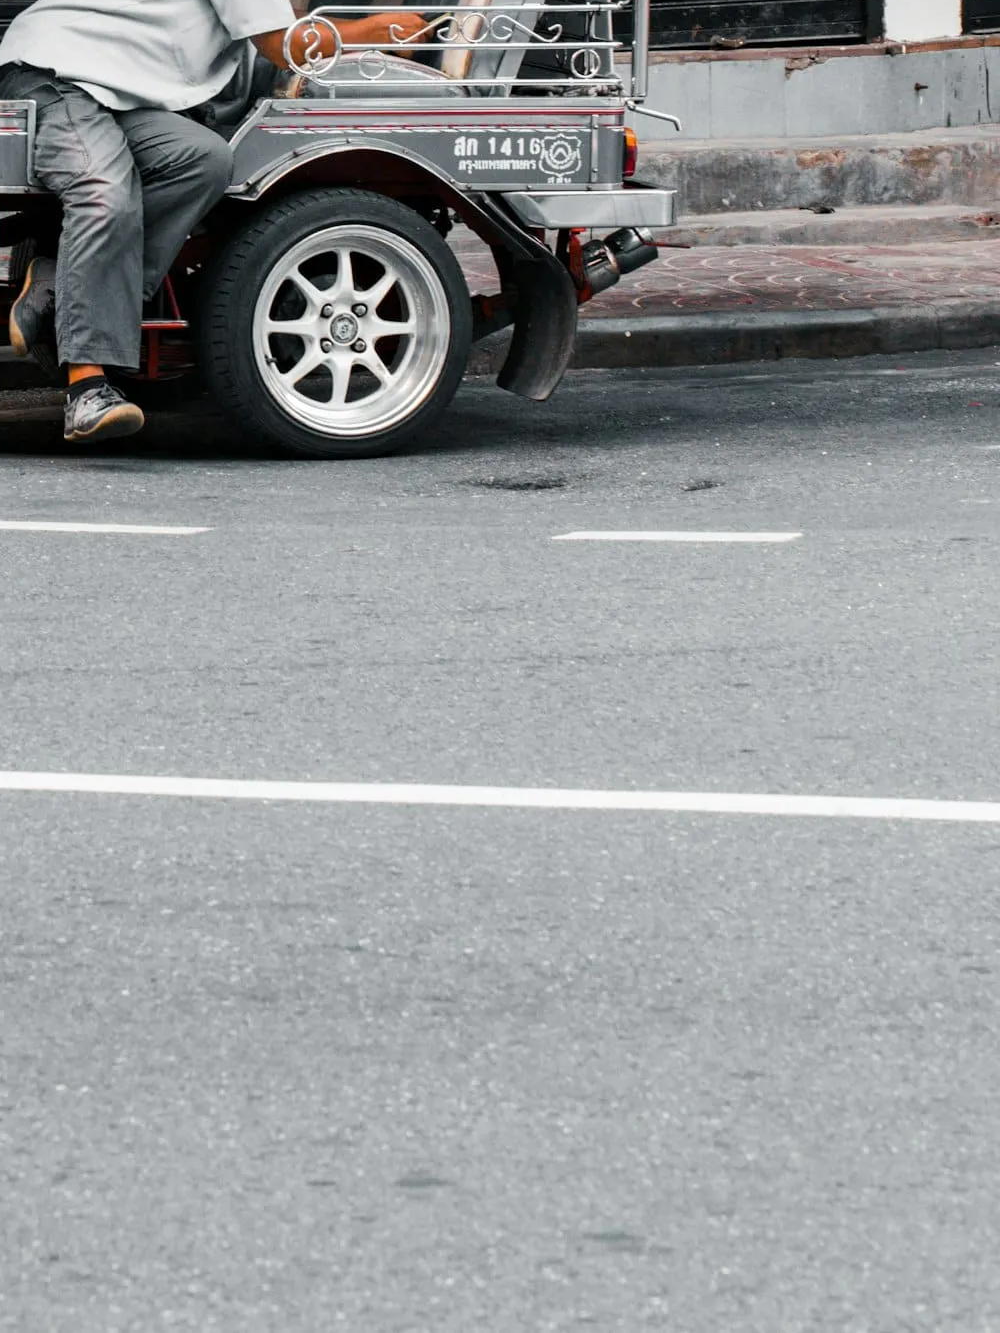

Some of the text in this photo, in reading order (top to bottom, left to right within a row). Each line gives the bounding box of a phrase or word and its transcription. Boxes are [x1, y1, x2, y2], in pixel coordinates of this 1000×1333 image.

[488, 137, 540, 156] 1416
[458, 159, 537, 174] กรุงเทพมหานคร
